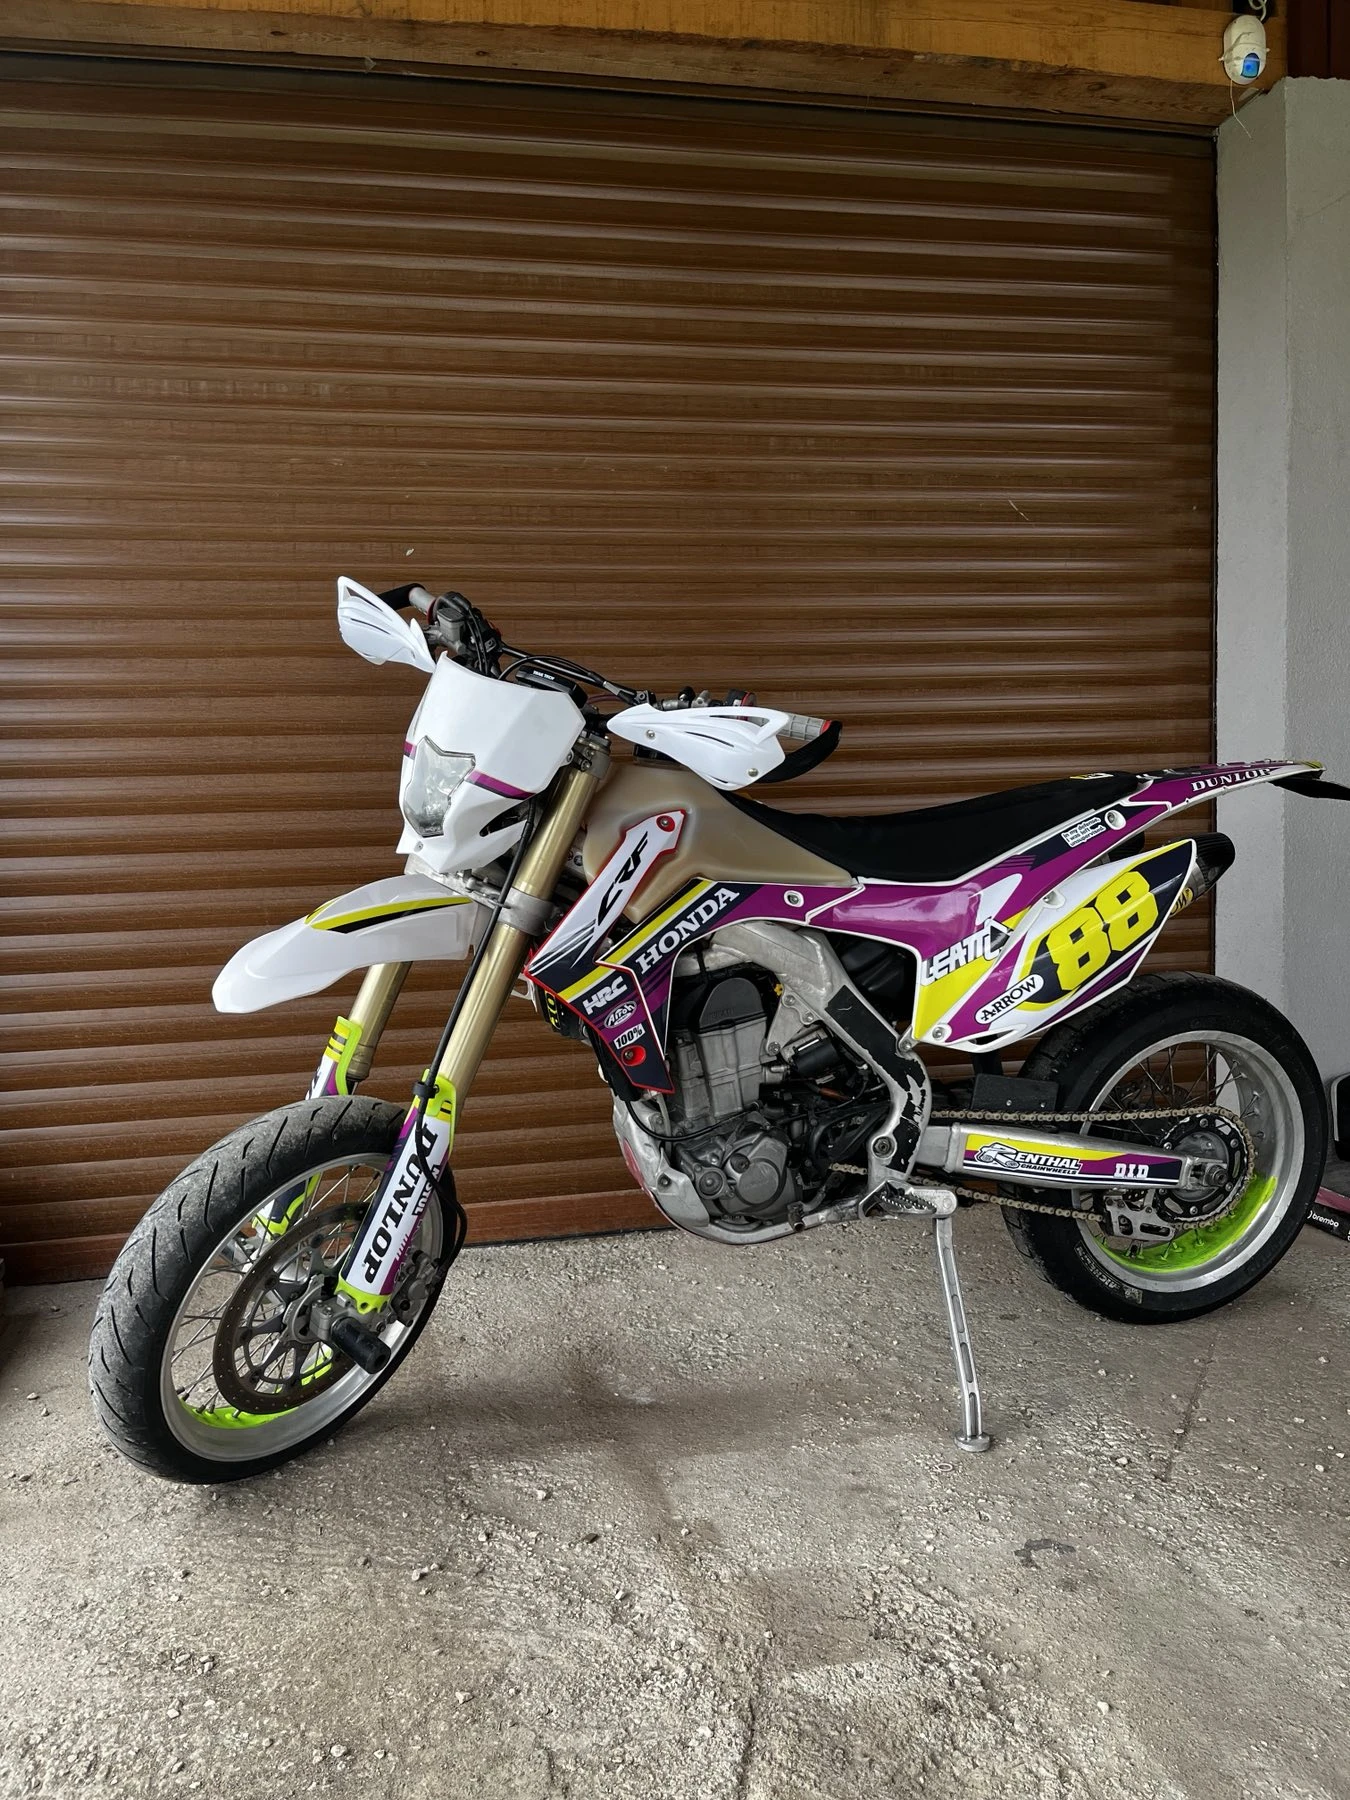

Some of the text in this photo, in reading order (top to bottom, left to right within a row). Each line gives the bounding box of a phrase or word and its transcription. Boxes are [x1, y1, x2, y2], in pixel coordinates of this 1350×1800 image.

[1191, 768, 1271, 792] DUNLOP
[598, 831, 648, 926] CRF
[635, 887, 740, 975] HONDA
[1046, 871, 1159, 992] 88
[582, 975, 628, 1015] HRC
[980, 976, 1037, 1021] ARROW
[615, 1025, 643, 1048] 100%
[1020, 1163, 1078, 1175] CHAINWHEELS
[363, 1123, 438, 1284] DUNLOP
[1312, 1212, 1339, 1228] brembo
